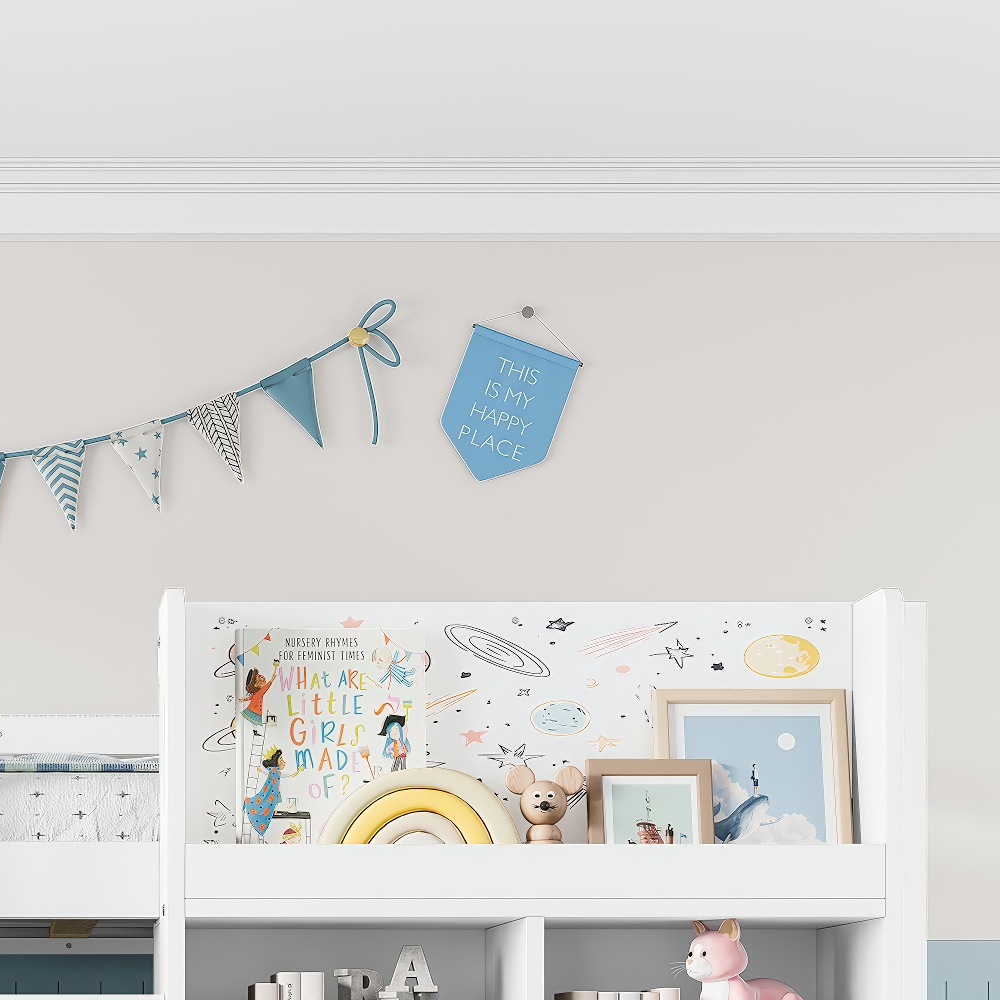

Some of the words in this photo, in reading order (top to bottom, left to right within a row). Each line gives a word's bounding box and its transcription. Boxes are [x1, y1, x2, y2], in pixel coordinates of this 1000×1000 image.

[499, 357, 540, 385] THIS
[485, 380, 501, 399] IS
[504, 387, 535, 409] MY
[470, 402, 532, 436] HAPPY
[458, 424, 525, 462] PLACE
[279, 651, 294, 661] FOR
[297, 651, 336, 661] FEMINIST
[339, 650, 365, 661] TIMES
[285, 638, 321, 648] NURSERY
[325, 637, 358, 648] RHYMES
[338, 668, 367, 690] ARE
